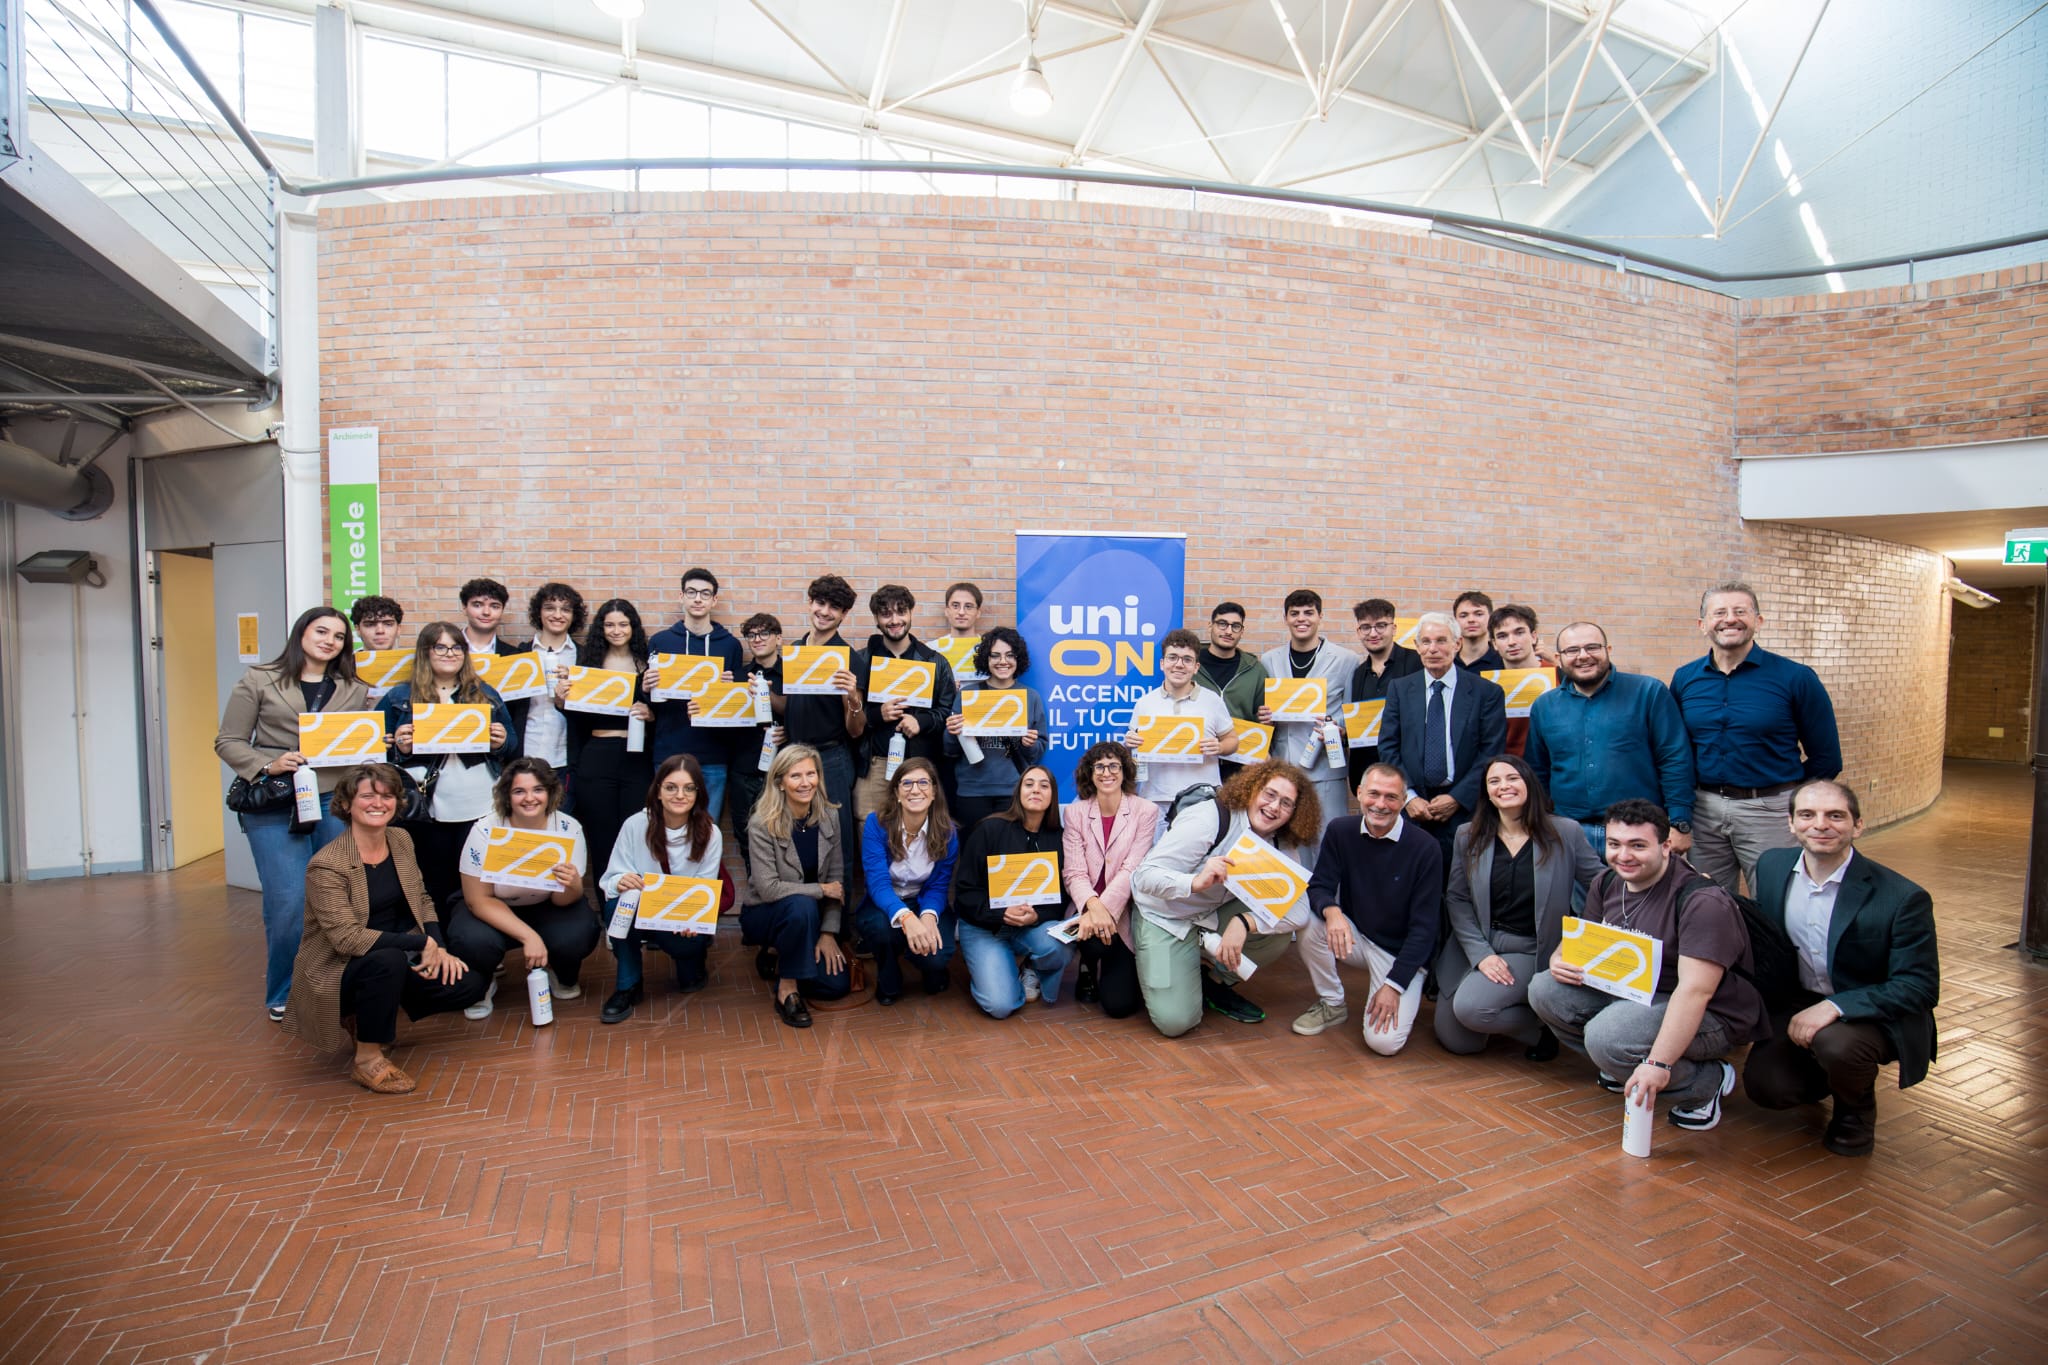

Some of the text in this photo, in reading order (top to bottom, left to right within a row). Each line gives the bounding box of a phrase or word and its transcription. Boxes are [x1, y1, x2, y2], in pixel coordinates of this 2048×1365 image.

[1049, 594, 1156, 636] uni.
[1049, 639, 1155, 677] ON
[1049, 708, 1069, 726] IL
